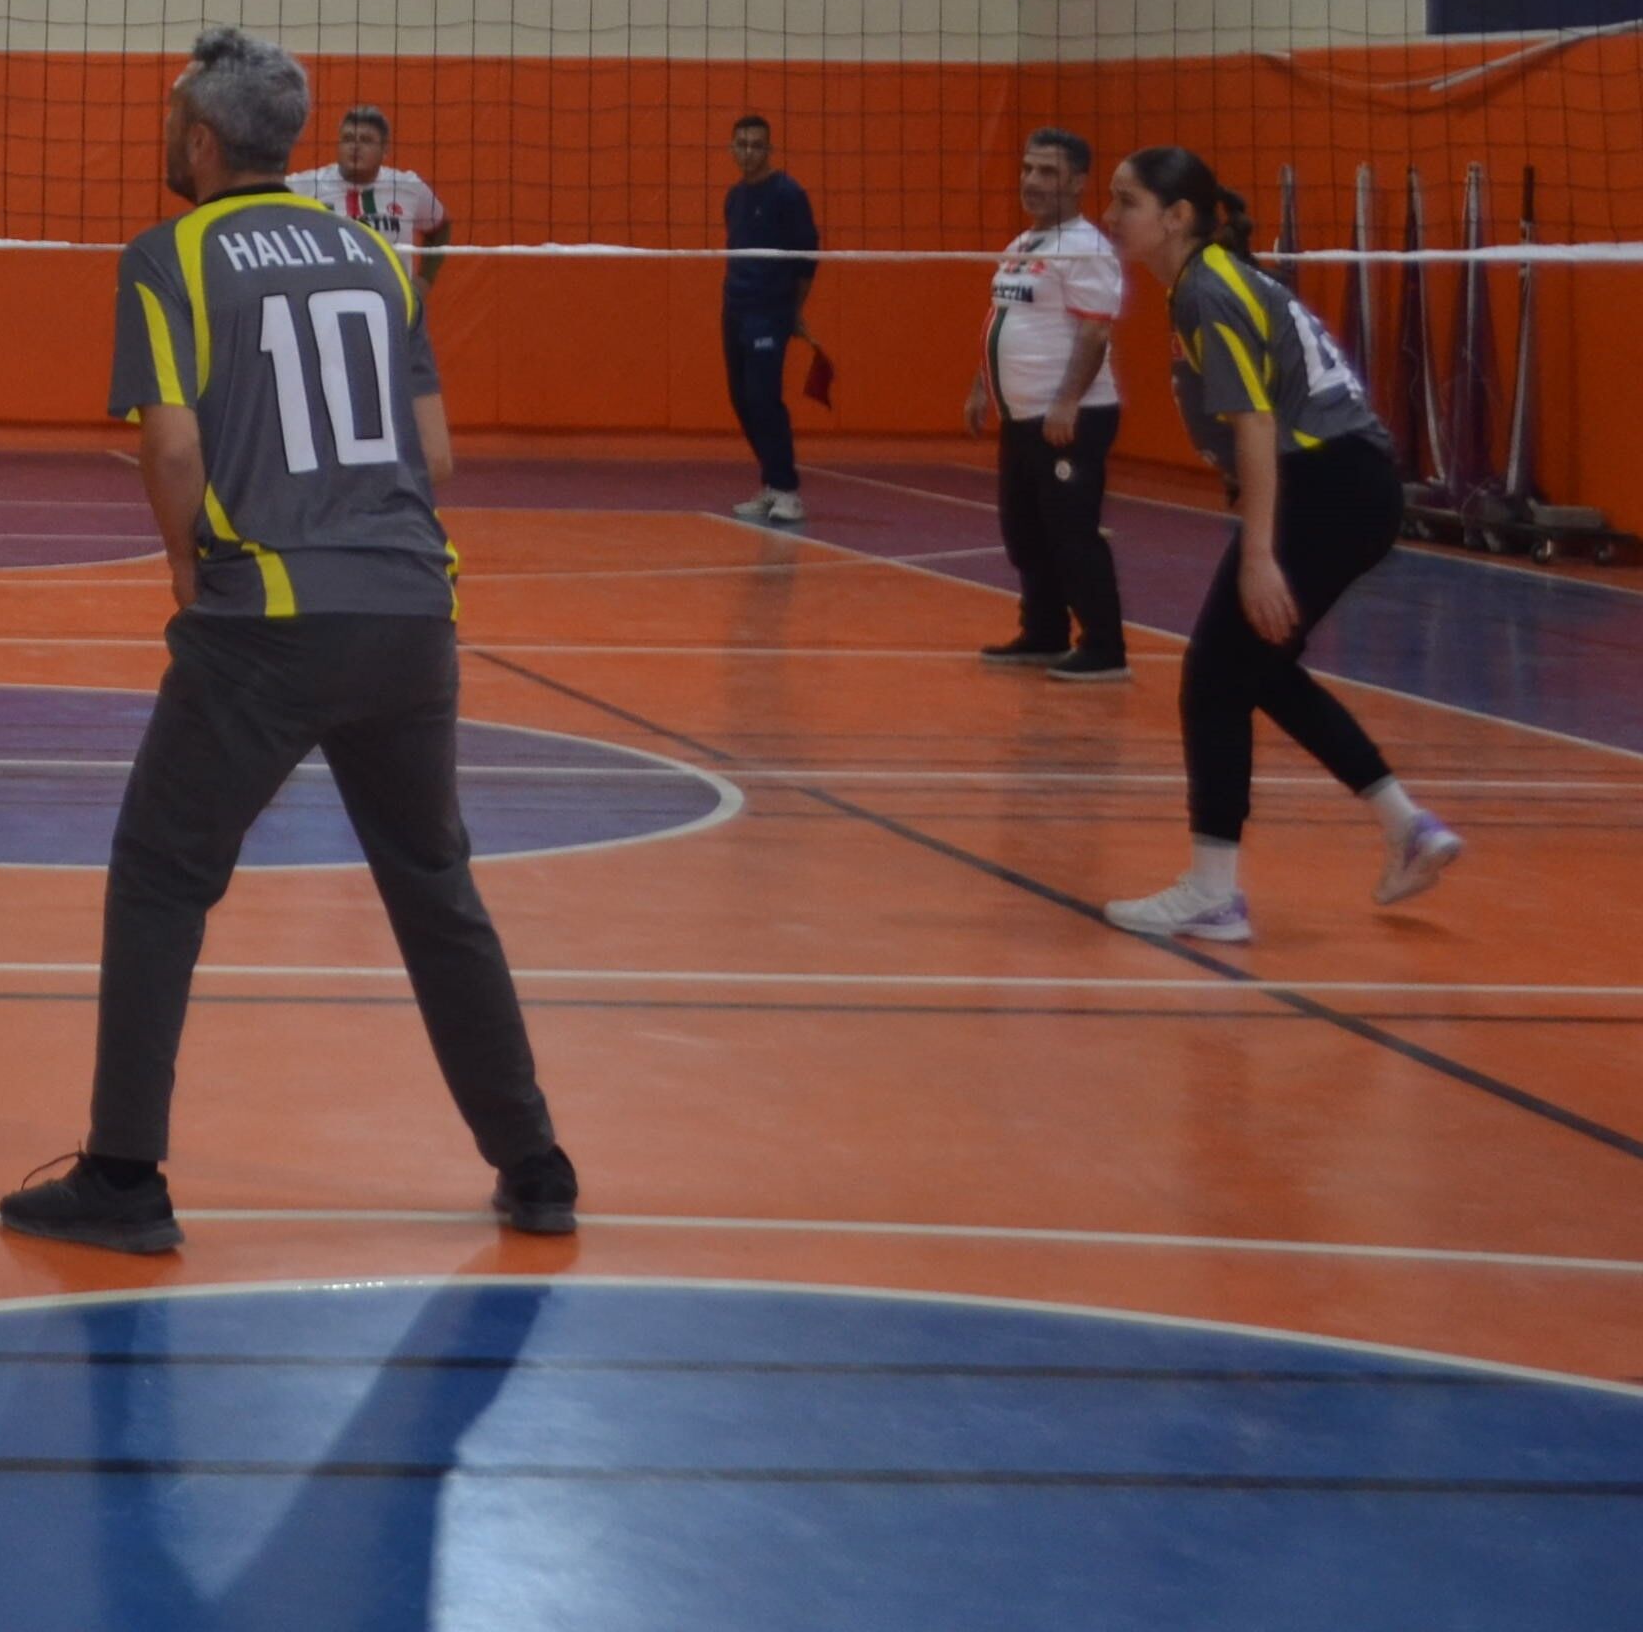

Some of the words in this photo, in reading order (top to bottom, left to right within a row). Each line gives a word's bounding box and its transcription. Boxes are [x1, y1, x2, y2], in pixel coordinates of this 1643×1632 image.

[218, 225, 335, 271] HALİL
[338, 227, 374, 265] A.
[260, 289, 399, 474] 10
